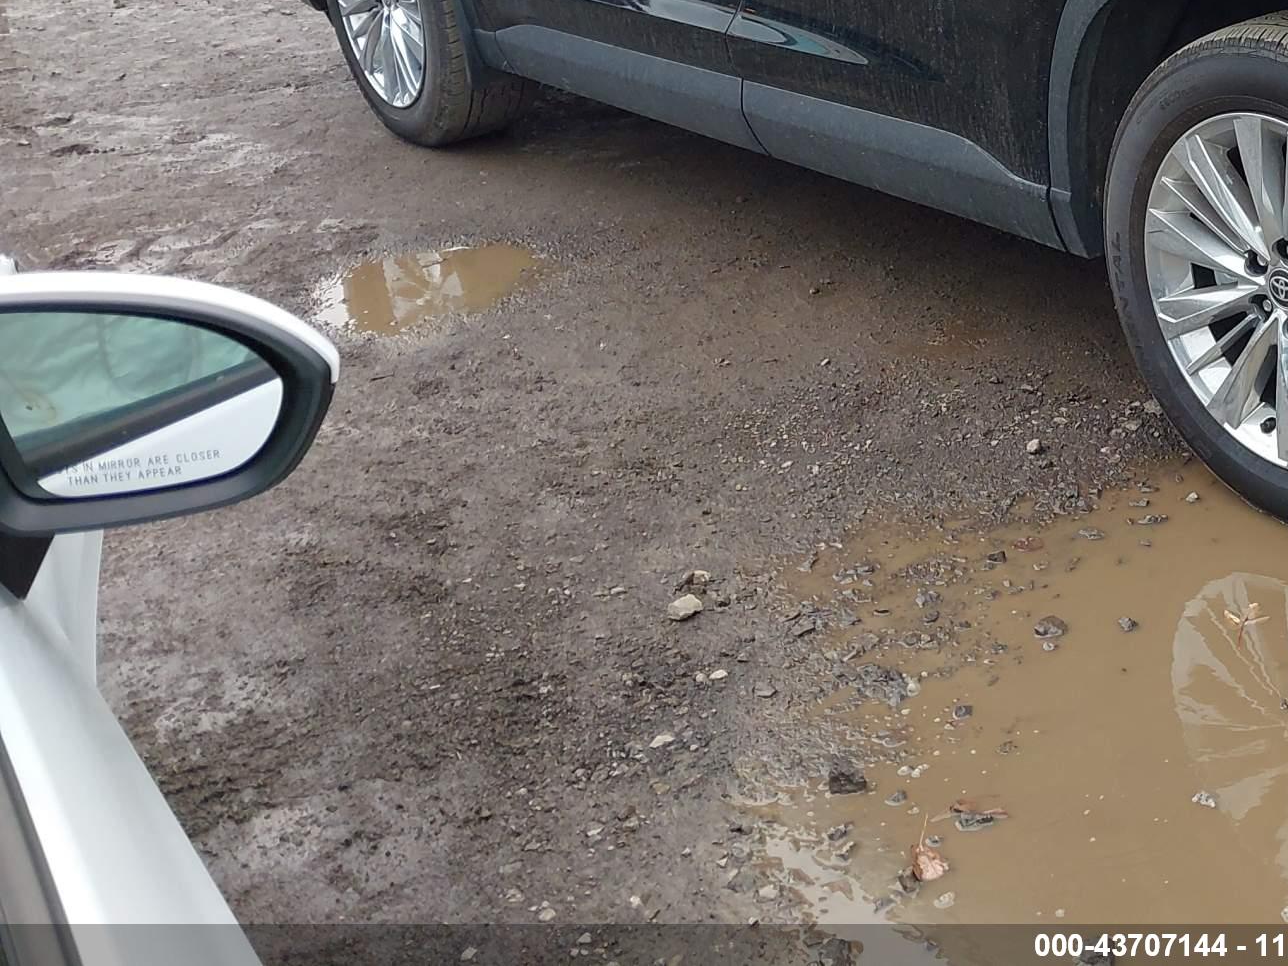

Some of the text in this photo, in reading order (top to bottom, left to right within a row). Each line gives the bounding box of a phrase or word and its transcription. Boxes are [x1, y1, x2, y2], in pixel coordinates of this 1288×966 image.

[83, 462, 93, 472] IN
[98, 458, 141, 470] MIRROR
[148, 455, 169, 466] ARE
[176, 450, 221, 463] CLOSER
[68, 466, 182, 485] THAN THEY APPEAR
